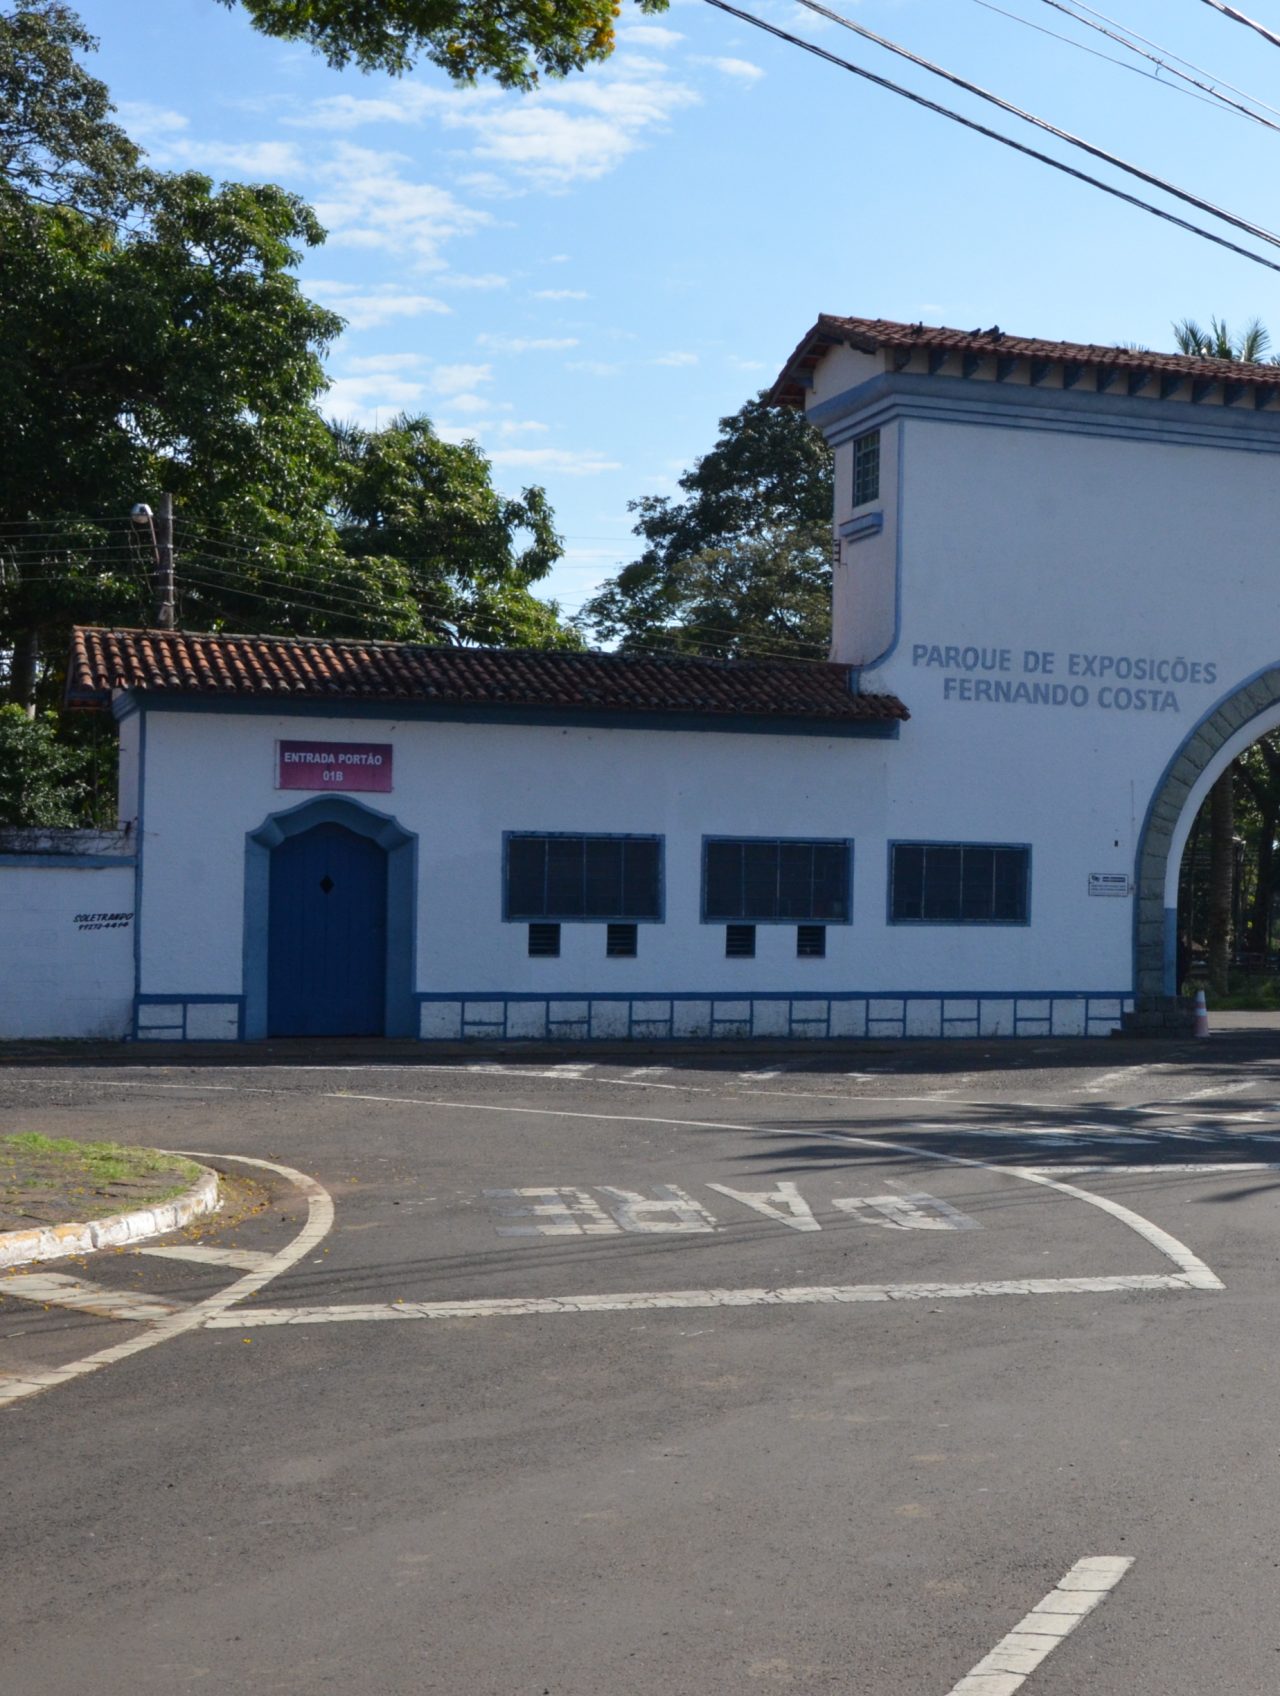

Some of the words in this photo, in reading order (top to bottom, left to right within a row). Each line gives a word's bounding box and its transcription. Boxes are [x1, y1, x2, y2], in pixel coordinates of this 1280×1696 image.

[912, 644, 1011, 671] PARQUE
[1023, 650, 1055, 674] DE
[1068, 653, 1217, 685] EXPOSIÇÕES
[943, 677, 1089, 708] FERNANDO
[1097, 686, 1180, 713] COSTA
[284, 752, 335, 763] ENTRADA
[338, 753, 383, 766] PORTÃO
[323, 770, 344, 781] 01B
[480, 1179, 986, 1237] PARE
